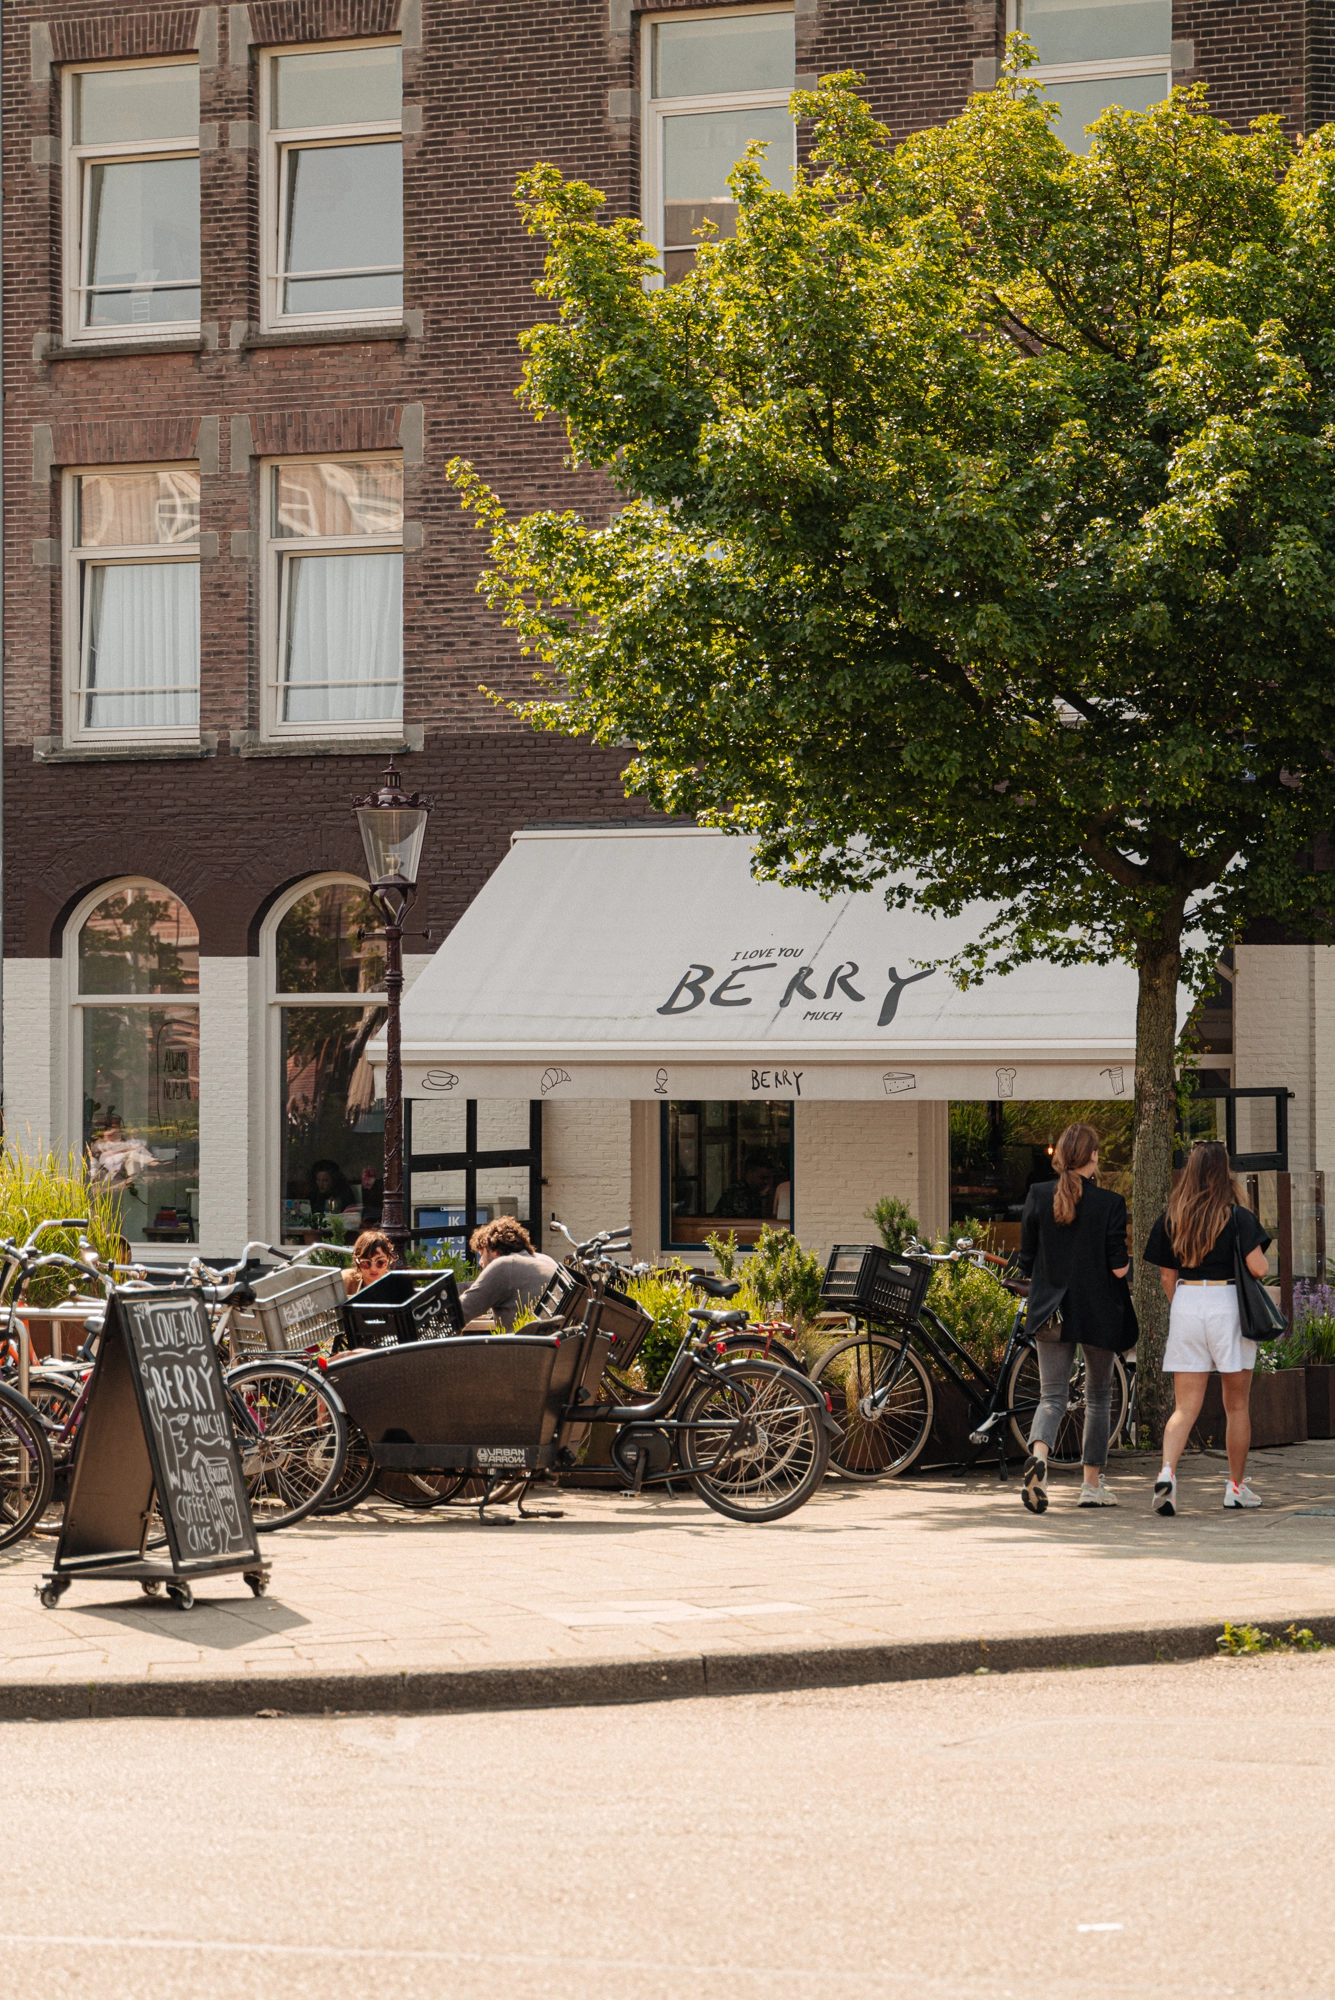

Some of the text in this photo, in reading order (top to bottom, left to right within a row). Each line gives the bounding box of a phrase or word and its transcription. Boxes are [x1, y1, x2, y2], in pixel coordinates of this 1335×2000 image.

[731, 947, 804, 961] I LOVE YOU
[656, 961, 936, 1027] BERRY
[802, 1011, 843, 1021] MUCH
[751, 1069, 804, 1096] BERRY
[448, 1216, 460, 1226] IK
[133, 1310, 203, 1348] I LOVE YOU
[150, 1364, 216, 1411] BERRY
[487, 1448, 525, 1456] URBAN
[488, 1455, 525, 1463] ARROW
[177, 1495, 211, 1525] COFFEE
[188, 1525, 216, 1551] CAKE
